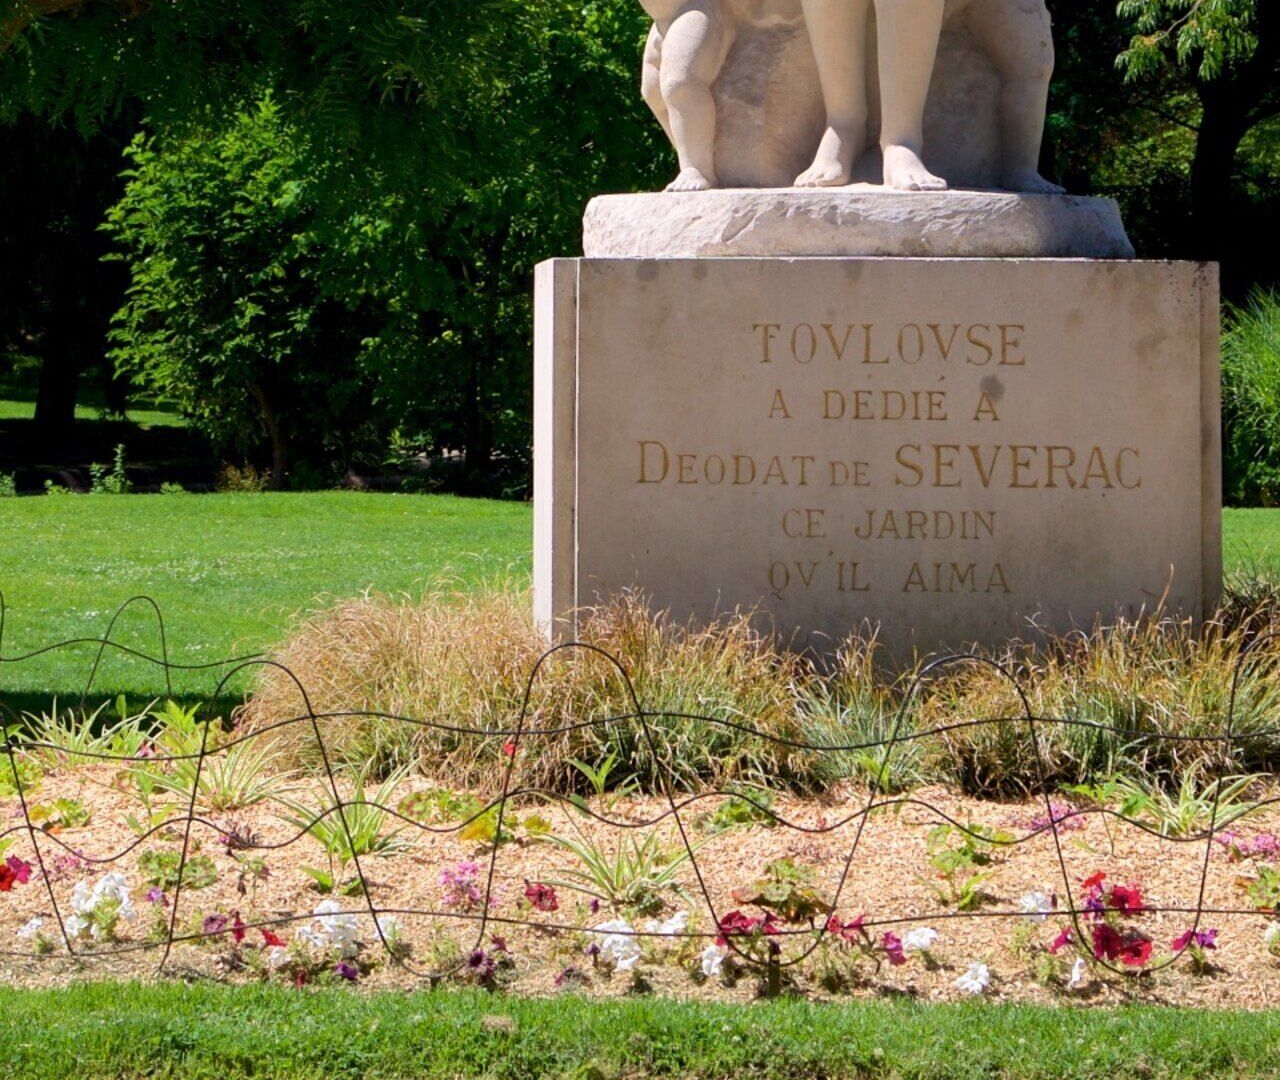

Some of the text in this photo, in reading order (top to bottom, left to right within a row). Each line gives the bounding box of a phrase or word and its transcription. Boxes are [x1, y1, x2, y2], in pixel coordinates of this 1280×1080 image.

[752, 323, 1027, 366] TOVLOVSE
[767, 388, 793, 419] A
[894, 444, 1143, 490] SEVERAC
[781, 508, 997, 541] CE JARDIN
[901, 561, 1013, 594] AIMA
